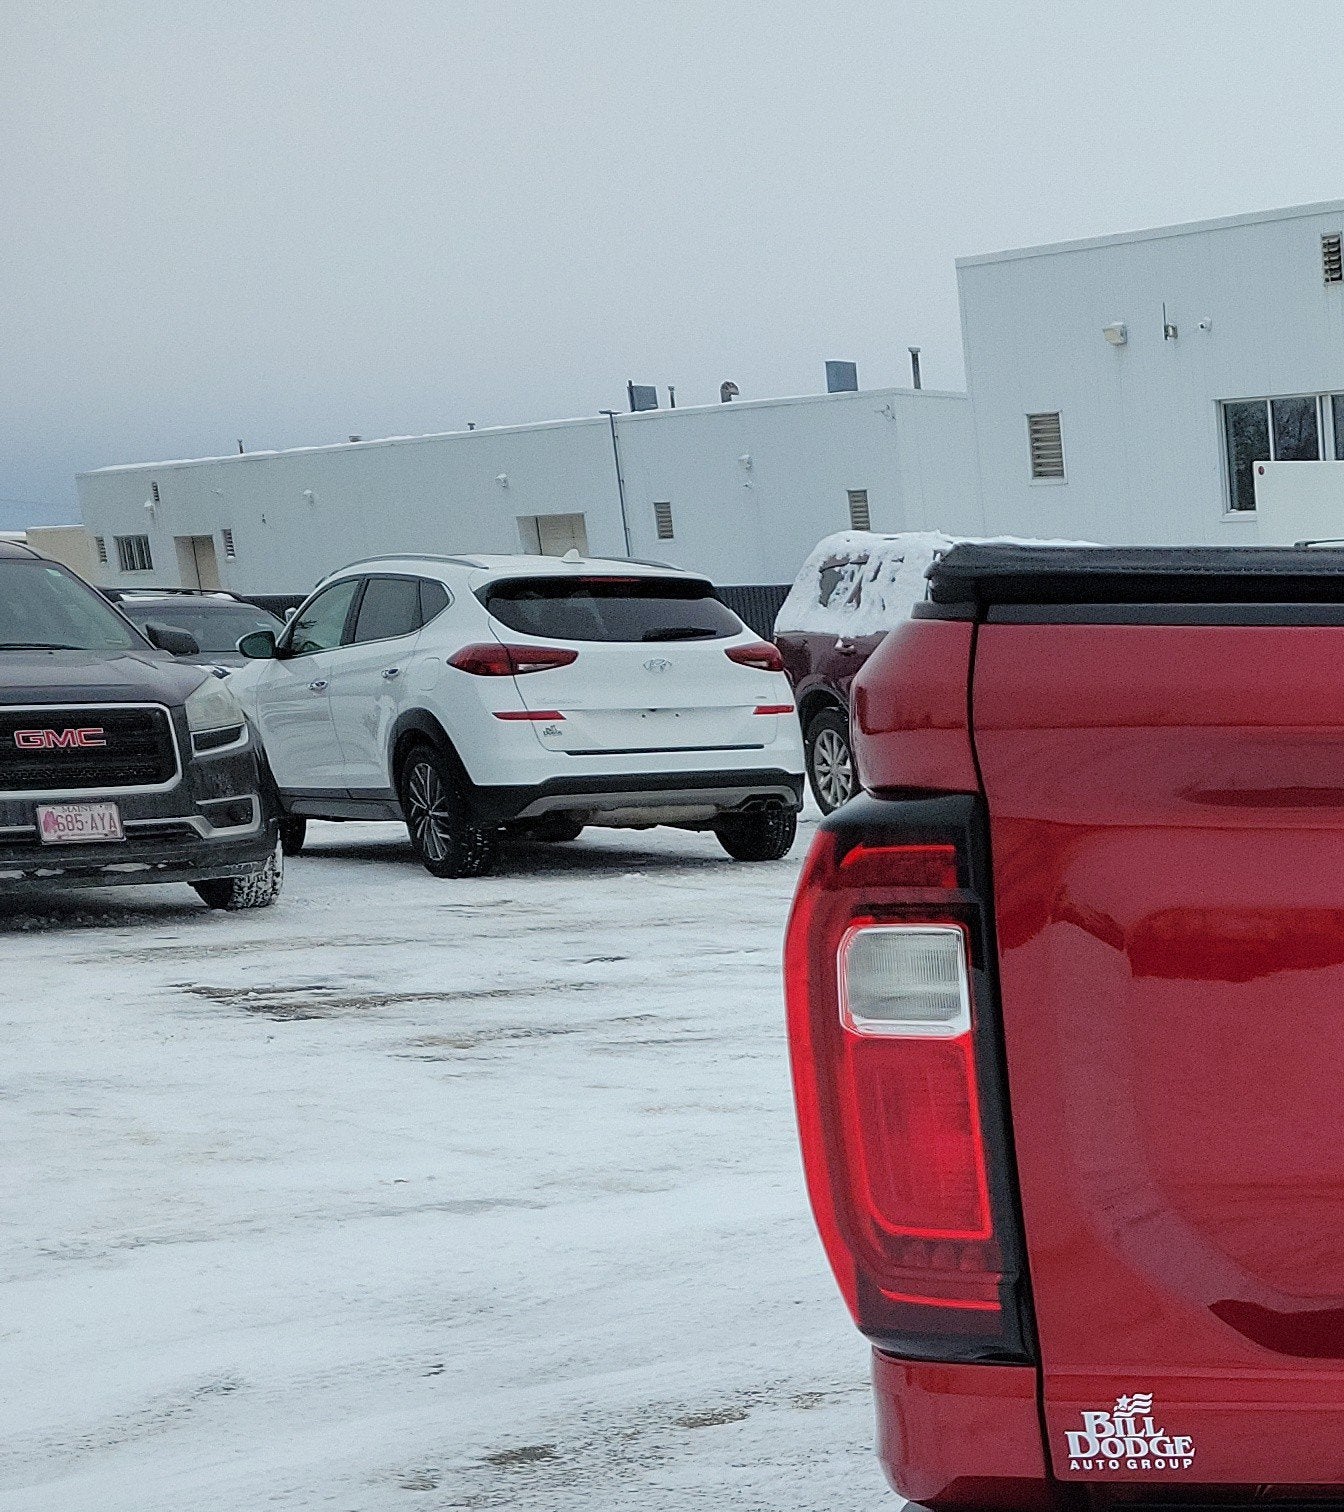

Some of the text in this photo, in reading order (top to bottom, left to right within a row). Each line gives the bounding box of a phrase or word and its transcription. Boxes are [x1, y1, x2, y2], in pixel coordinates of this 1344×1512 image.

[14, 727, 106, 748] GMC
[1080, 1411, 1165, 1438] BILL
[1064, 1431, 1195, 1458] DODGE
[1070, 1459, 1192, 1470] AUTO GROUP
